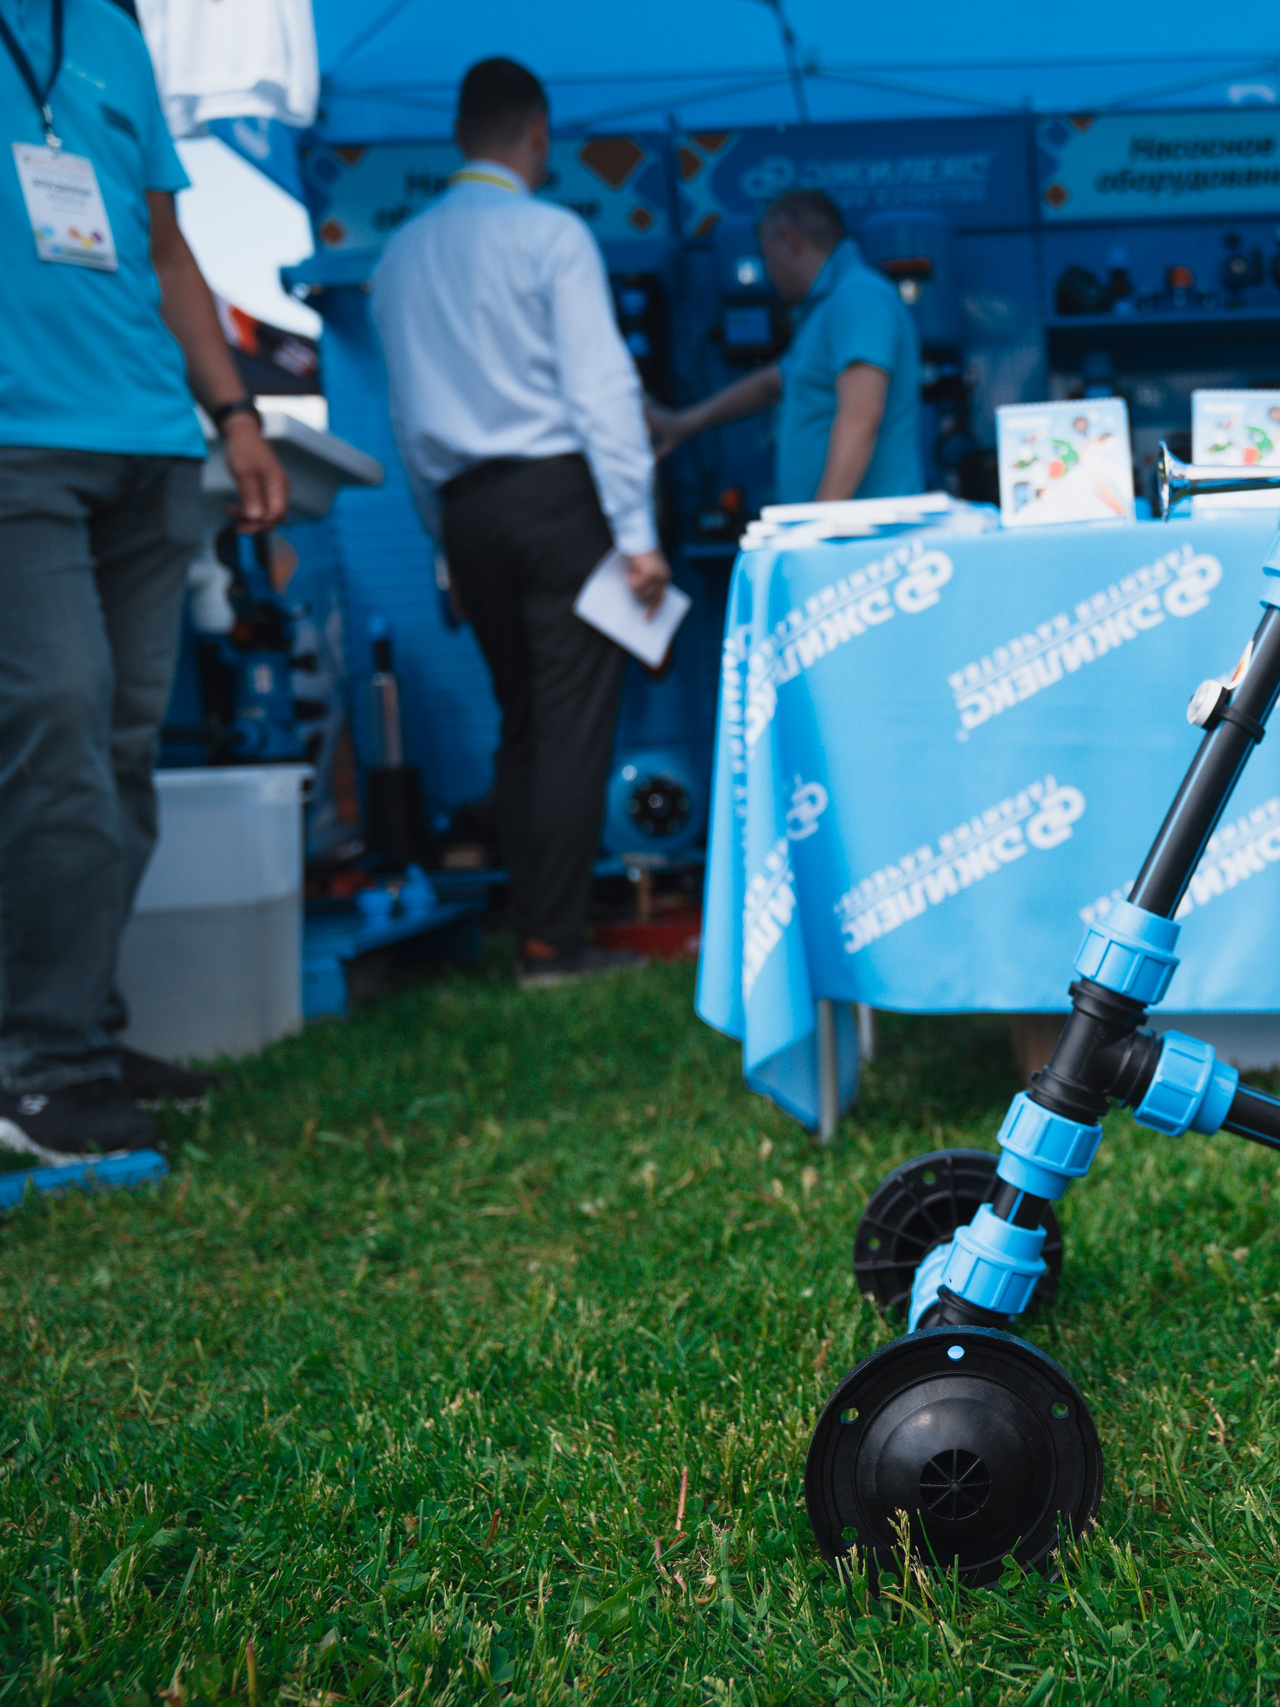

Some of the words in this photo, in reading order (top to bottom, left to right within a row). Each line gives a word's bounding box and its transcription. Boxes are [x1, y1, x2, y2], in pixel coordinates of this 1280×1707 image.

[1130, 135, 1275, 160] Насосное
[1071, 542, 1197, 623] ГАРАНТИЯ
[945, 612, 1073, 694] КАЧЕСТВА
